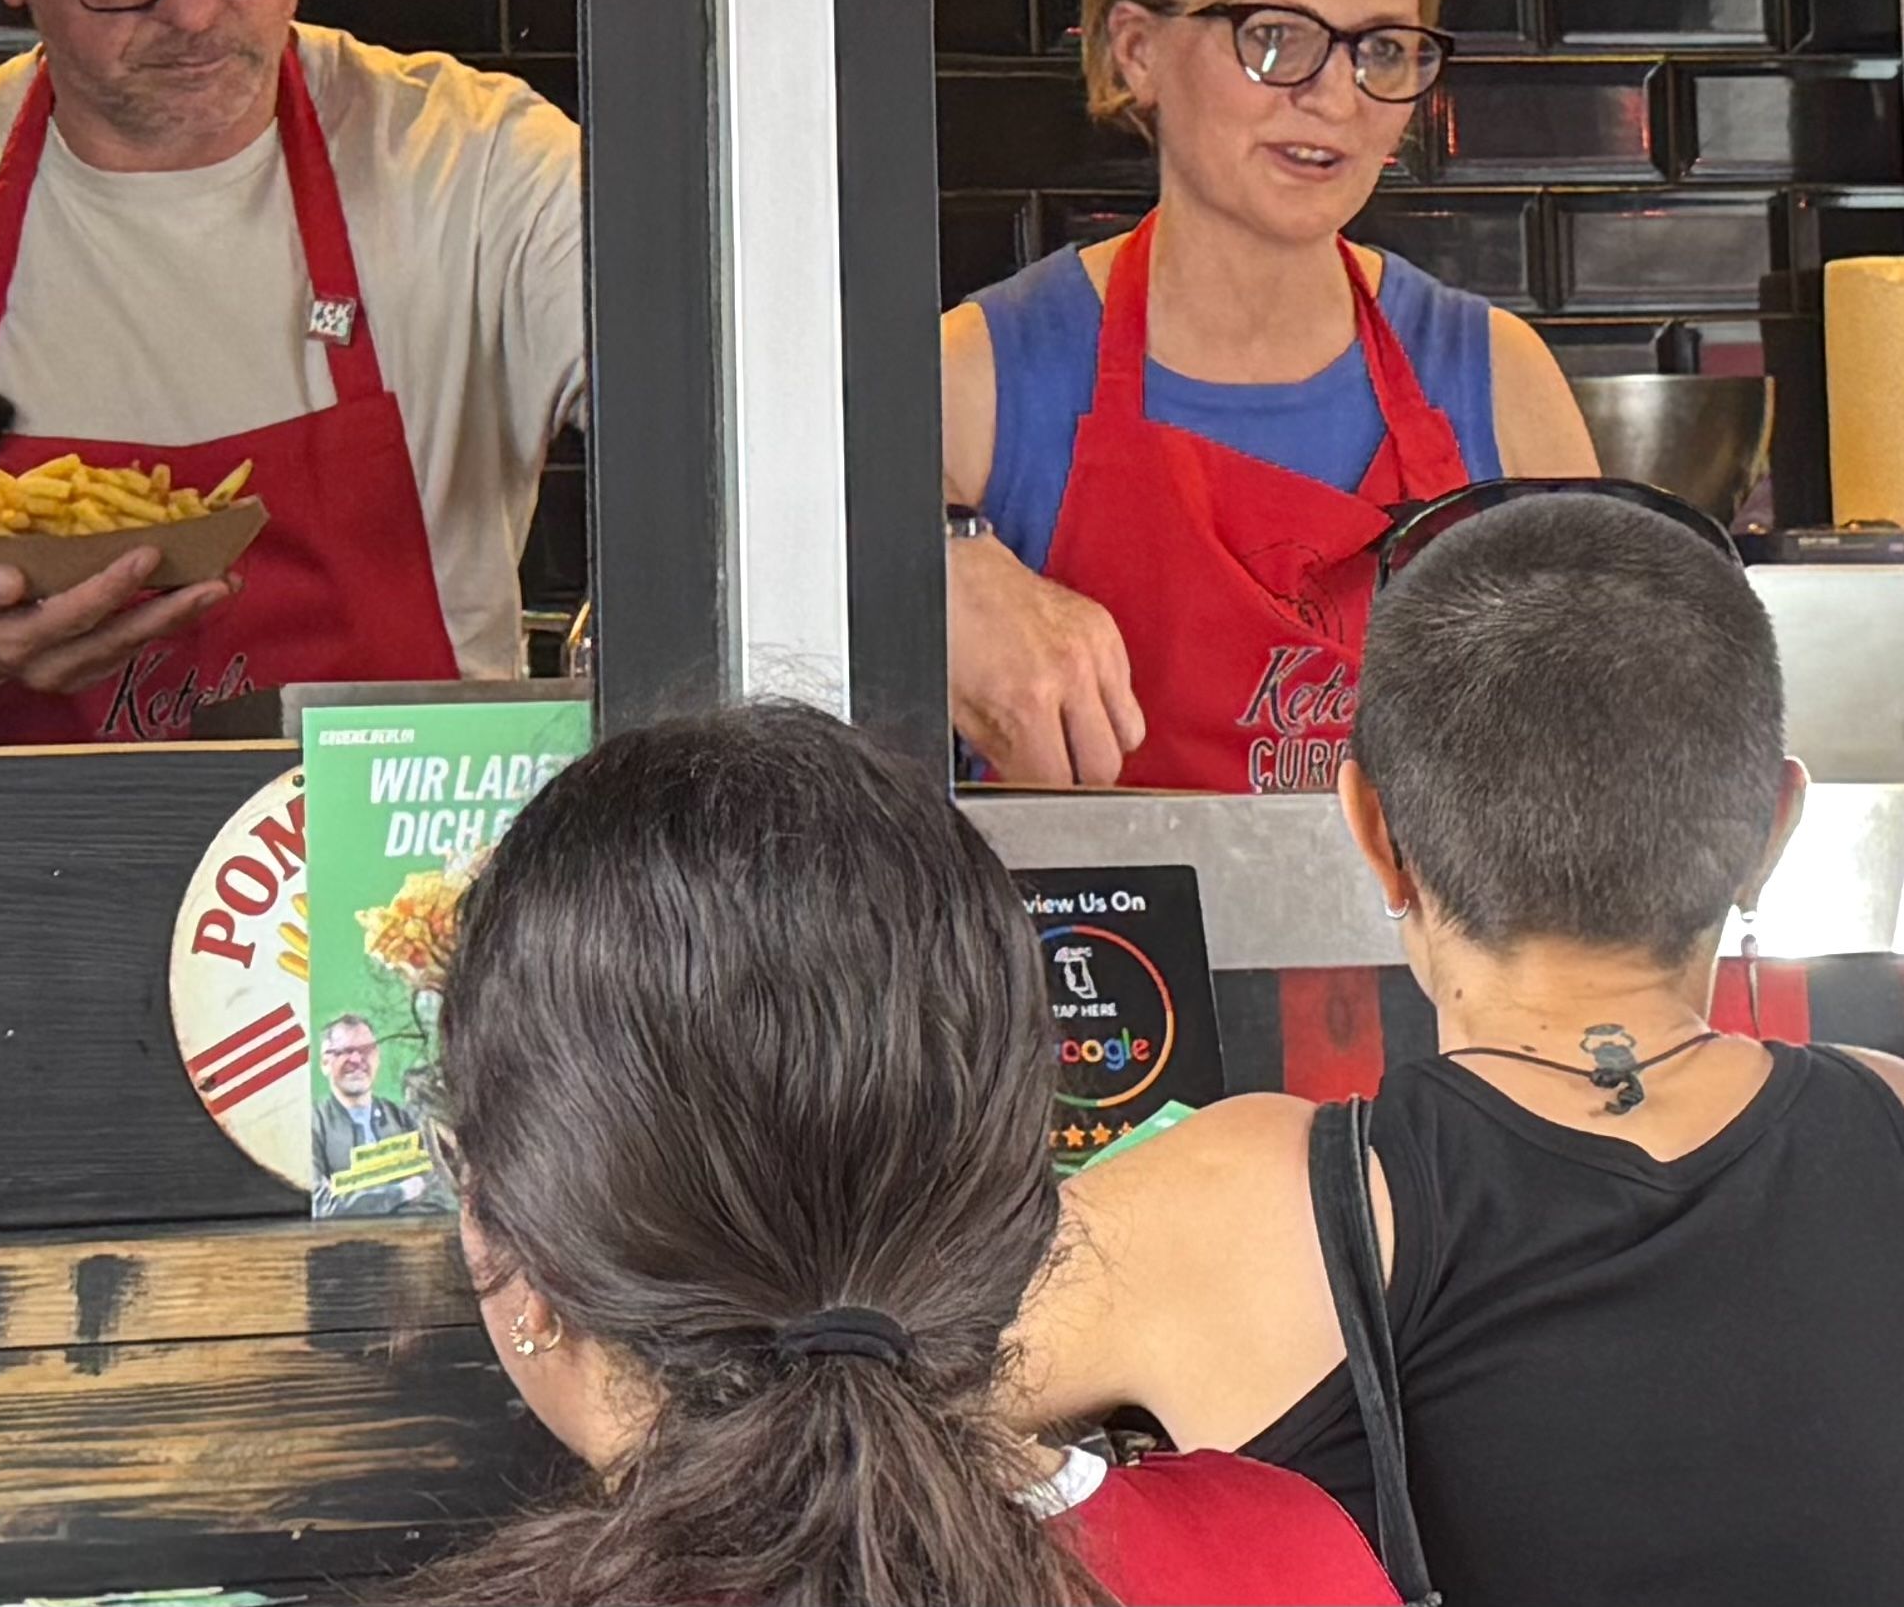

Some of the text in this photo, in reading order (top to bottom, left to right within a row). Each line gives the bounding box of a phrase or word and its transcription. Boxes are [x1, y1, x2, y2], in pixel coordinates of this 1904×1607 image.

[1236, 646, 1360, 740] Kete
[370, 756, 450, 804] WIR
[1249, 737, 1351, 794] CUR
[384, 809, 486, 857] DICH
[1022, 891, 1146, 914] view Us On
[1081, 1001, 1118, 1018] HERE
[1054, 1026, 1152, 1072] oogle
